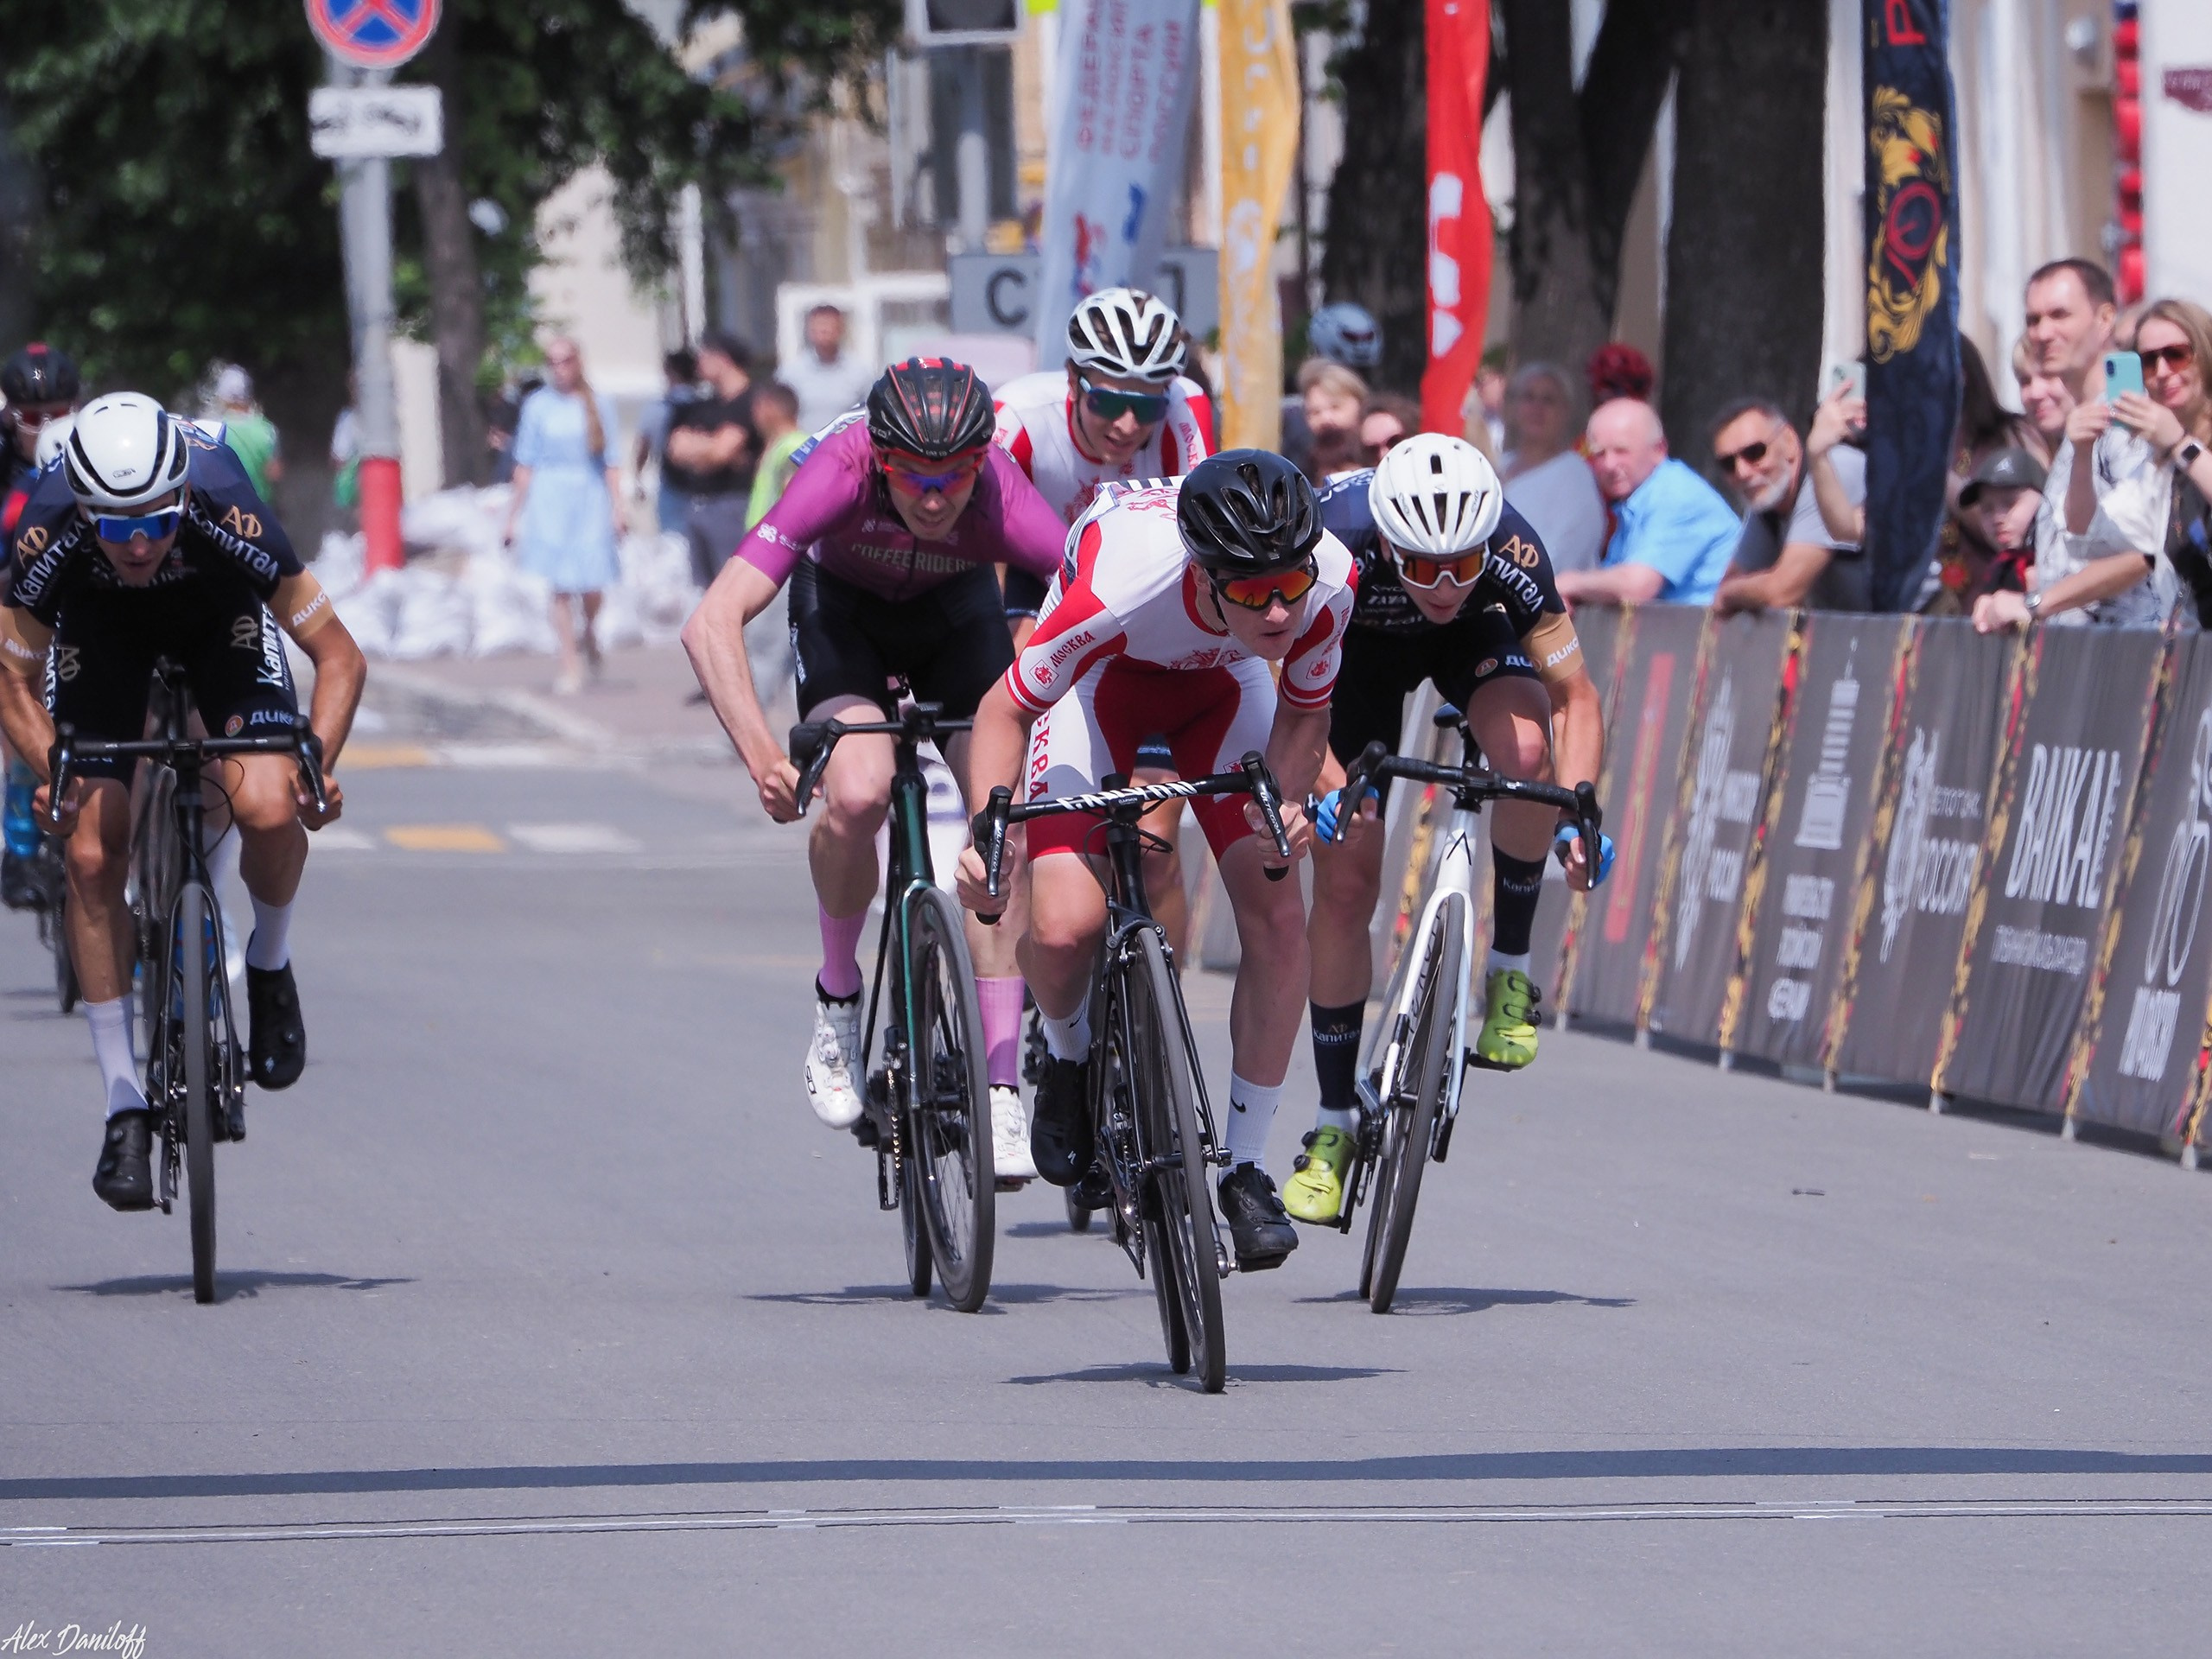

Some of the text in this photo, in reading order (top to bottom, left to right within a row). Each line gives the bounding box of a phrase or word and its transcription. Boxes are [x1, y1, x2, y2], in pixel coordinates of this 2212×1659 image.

[188, 501, 279, 582] Капитал
[220, 505, 263, 539] АФ
[13, 519, 86, 607] Капитал
[16, 525, 49, 569] АФ
[1498, 535, 1540, 569] АФ
[1050, 630, 1096, 668] МОСКВА
[1260, 791, 1281, 835] ULTEGRA
